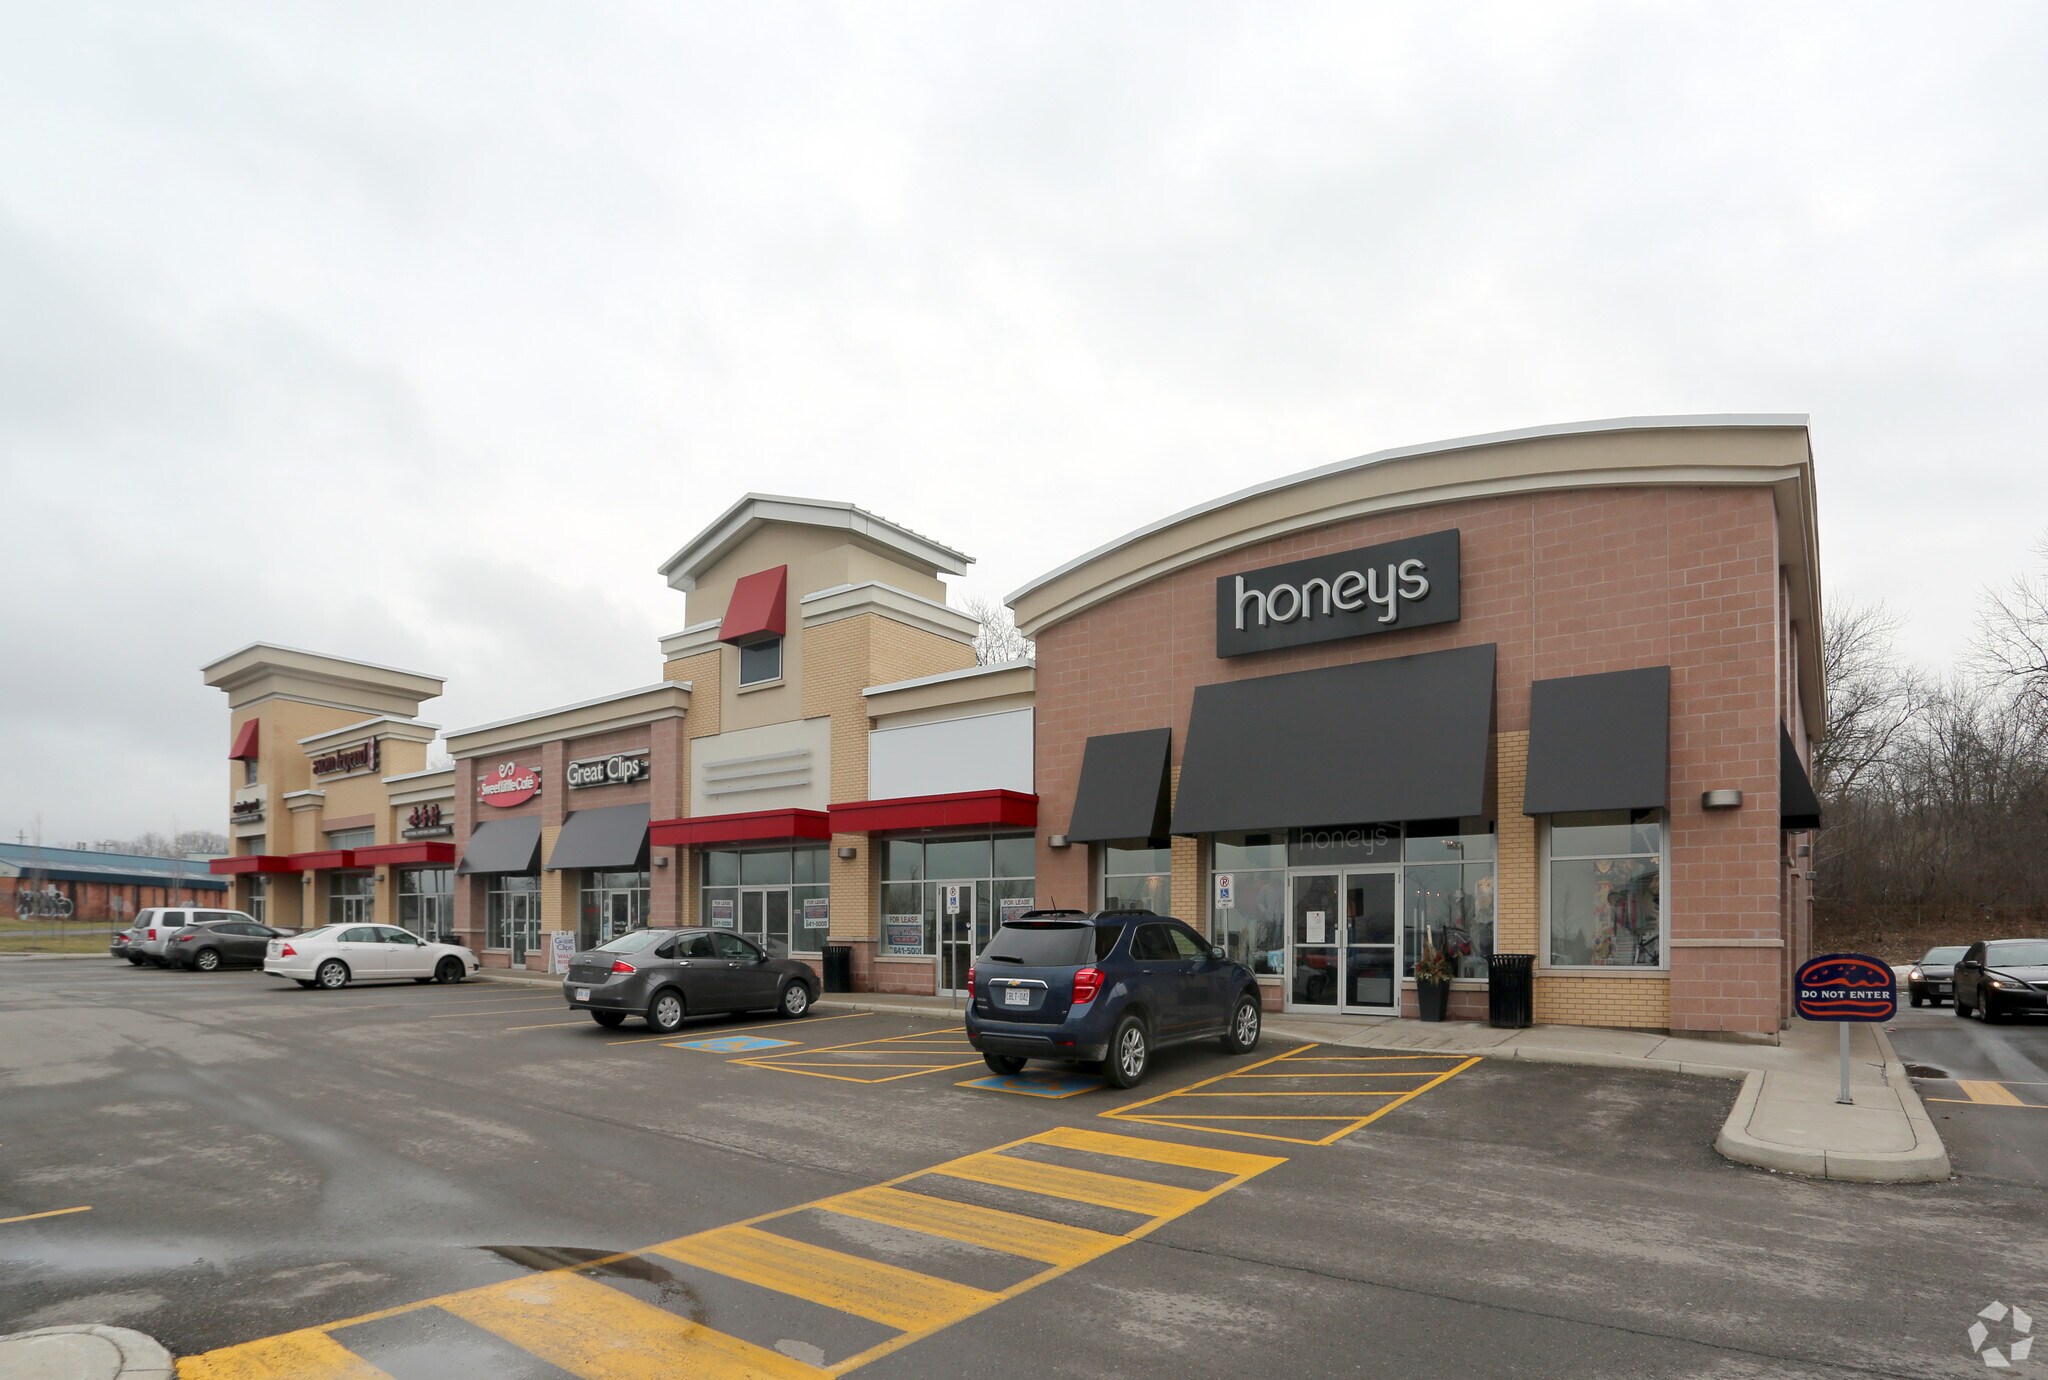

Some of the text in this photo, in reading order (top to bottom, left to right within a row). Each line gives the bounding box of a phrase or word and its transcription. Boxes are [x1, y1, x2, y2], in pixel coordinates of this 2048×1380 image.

[1235, 558, 1430, 630] honeys
[567, 756, 640, 785] Great Clips
[1300, 827, 1388, 855] honeys
[889, 916, 919, 924] FOR LEASE
[554, 937, 574, 945] Great
[1801, 990, 1890, 999] DO NOT ENTER
